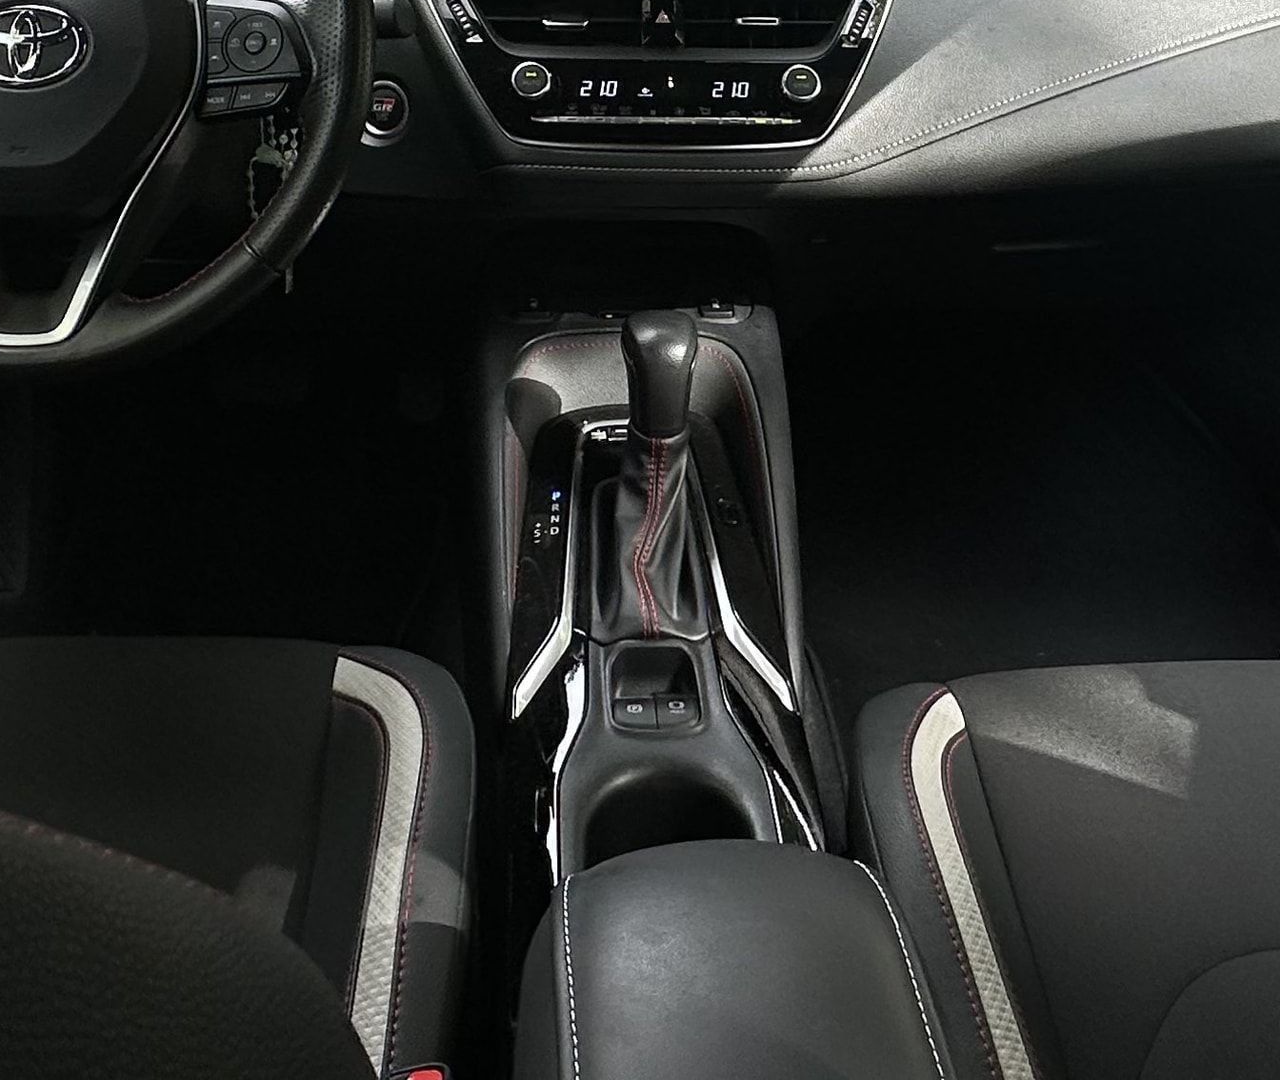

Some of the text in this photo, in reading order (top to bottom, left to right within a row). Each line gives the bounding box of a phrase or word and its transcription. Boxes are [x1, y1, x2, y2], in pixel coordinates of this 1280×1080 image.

[551, 491, 561, 501] P
[551, 503, 560, 512] R
[550, 514, 560, 524] N
[550, 526, 560, 535] D
